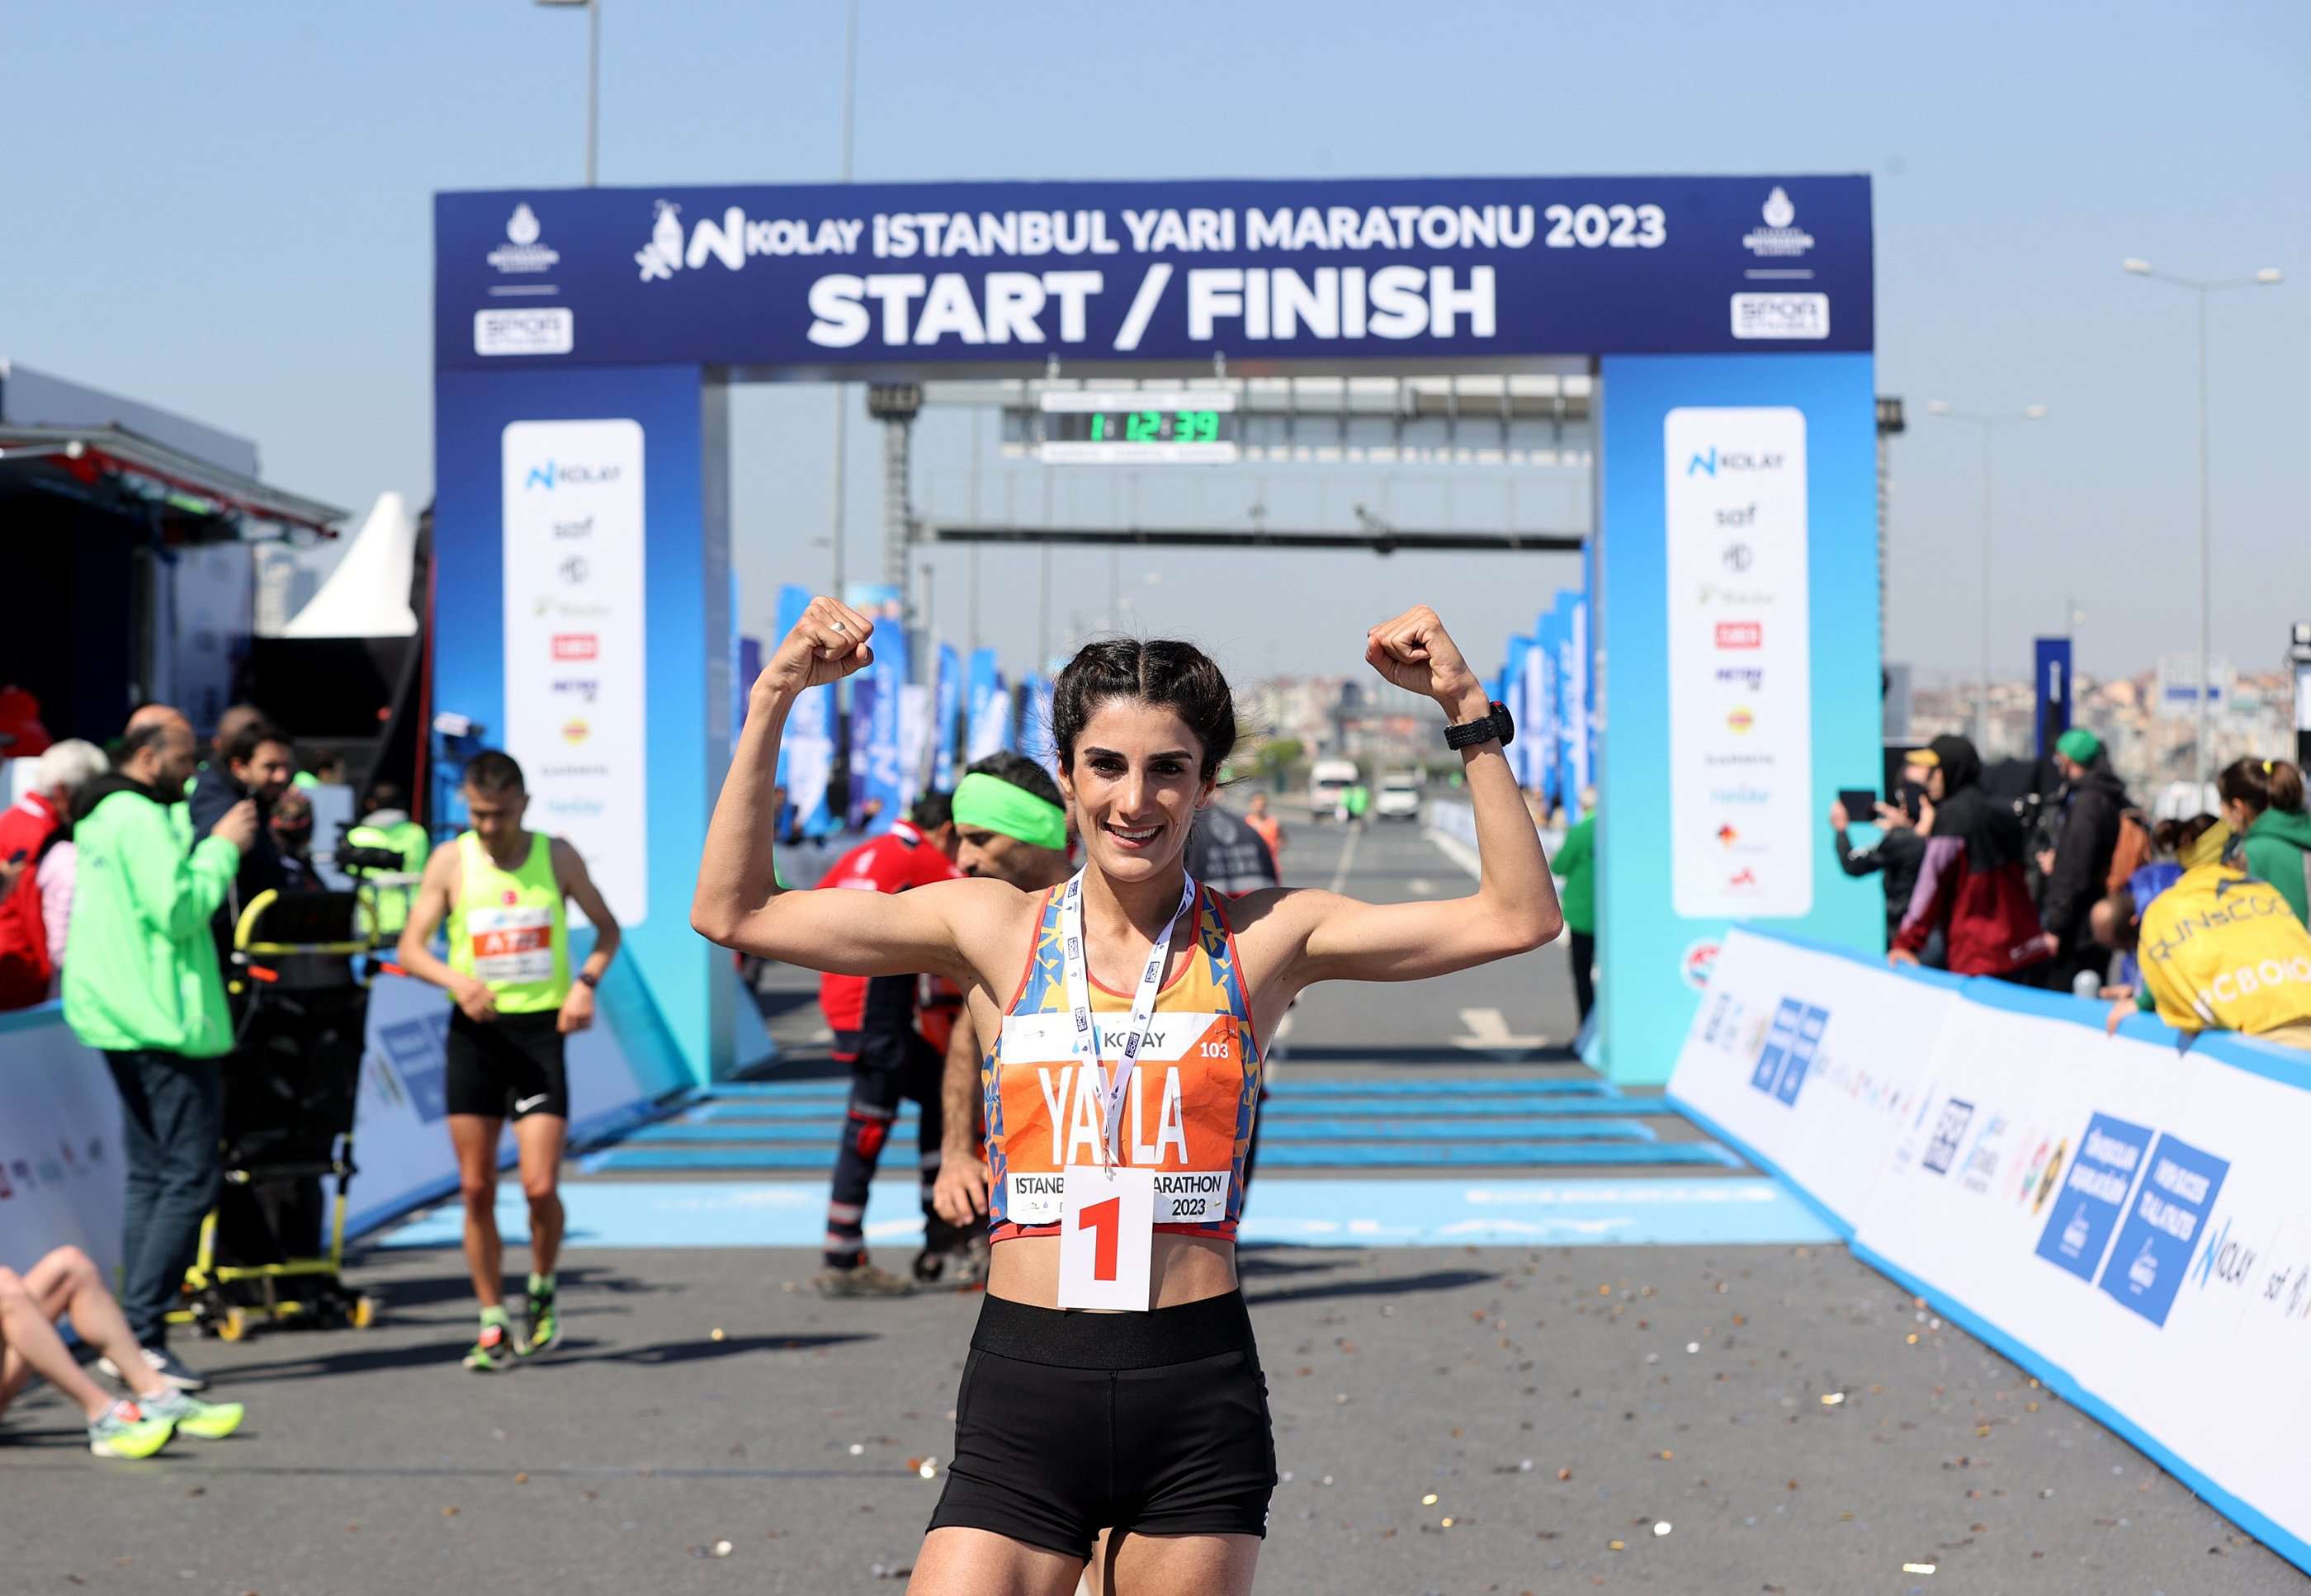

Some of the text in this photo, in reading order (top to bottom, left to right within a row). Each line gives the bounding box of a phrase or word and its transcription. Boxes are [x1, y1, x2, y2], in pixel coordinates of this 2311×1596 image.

[1122, 208, 1235, 252] YARI
[1245, 205, 1534, 251] MARATONU
[1545, 204, 1666, 248] 2023
[807, 272, 1103, 347] START
[1188, 266, 1496, 339] FINISH
[1200, 1041, 1229, 1059] 103
[1038, 1065, 1189, 1165] YAYLA
[1015, 1175, 1222, 1194] ISTANB ARATHON
[1172, 1197, 1207, 1216] 2023
[1078, 1196, 1121, 1282] 1
